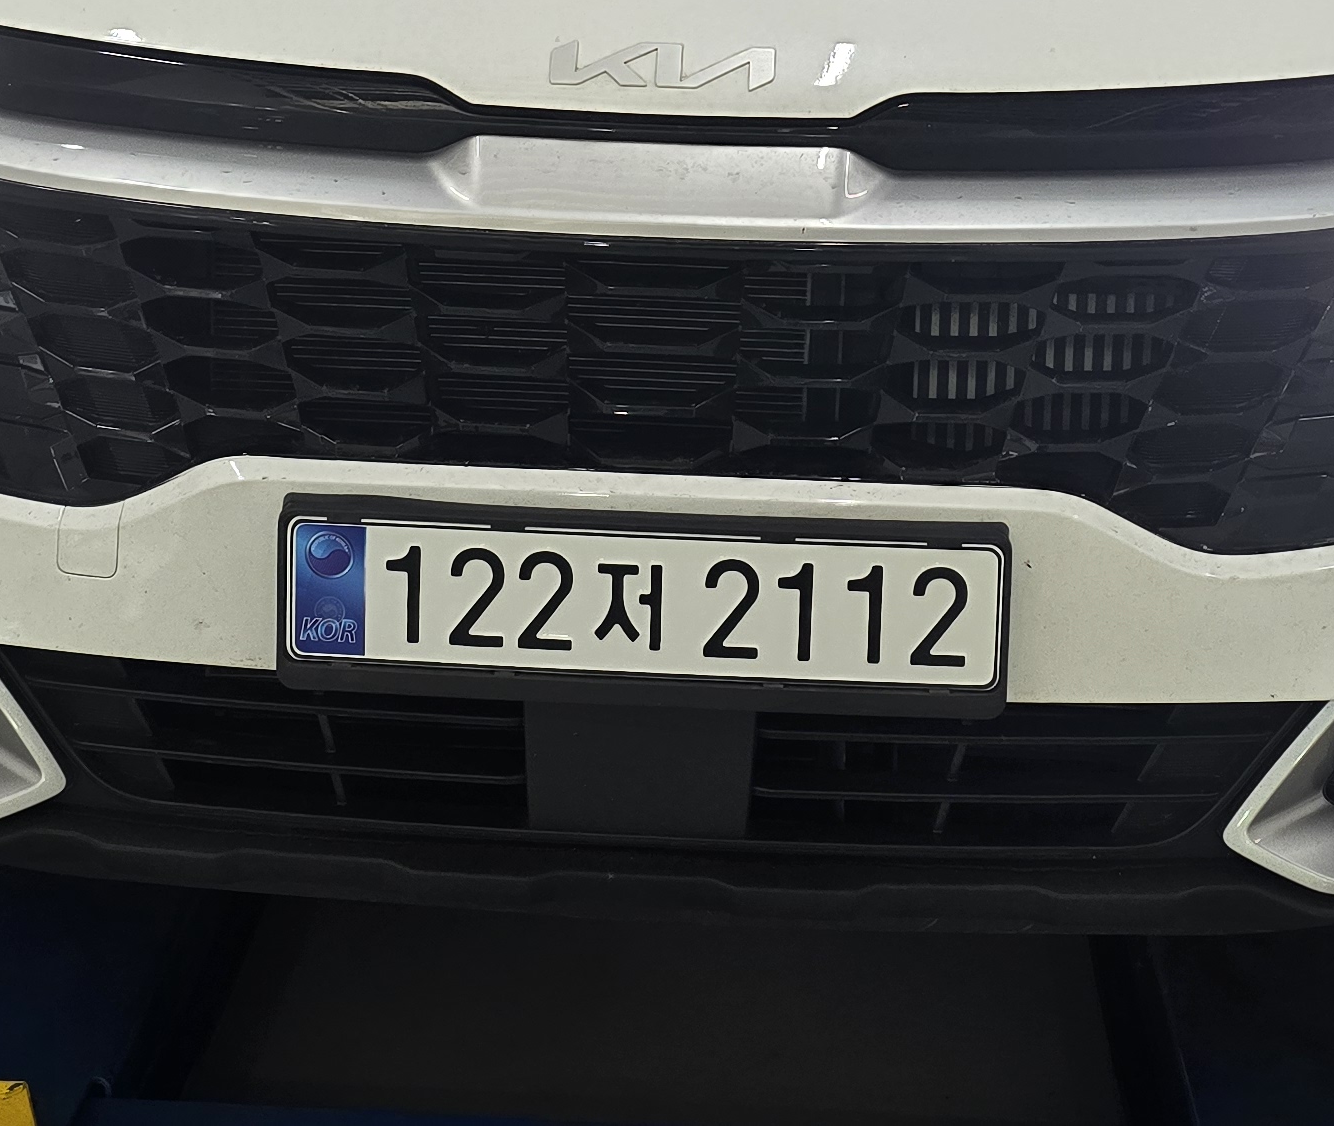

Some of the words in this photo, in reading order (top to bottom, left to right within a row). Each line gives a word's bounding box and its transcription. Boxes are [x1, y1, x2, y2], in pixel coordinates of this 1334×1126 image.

[300, 617, 357, 643] KOR
[385, 545, 663, 651] 122저
[702, 558, 970, 668] 2112
